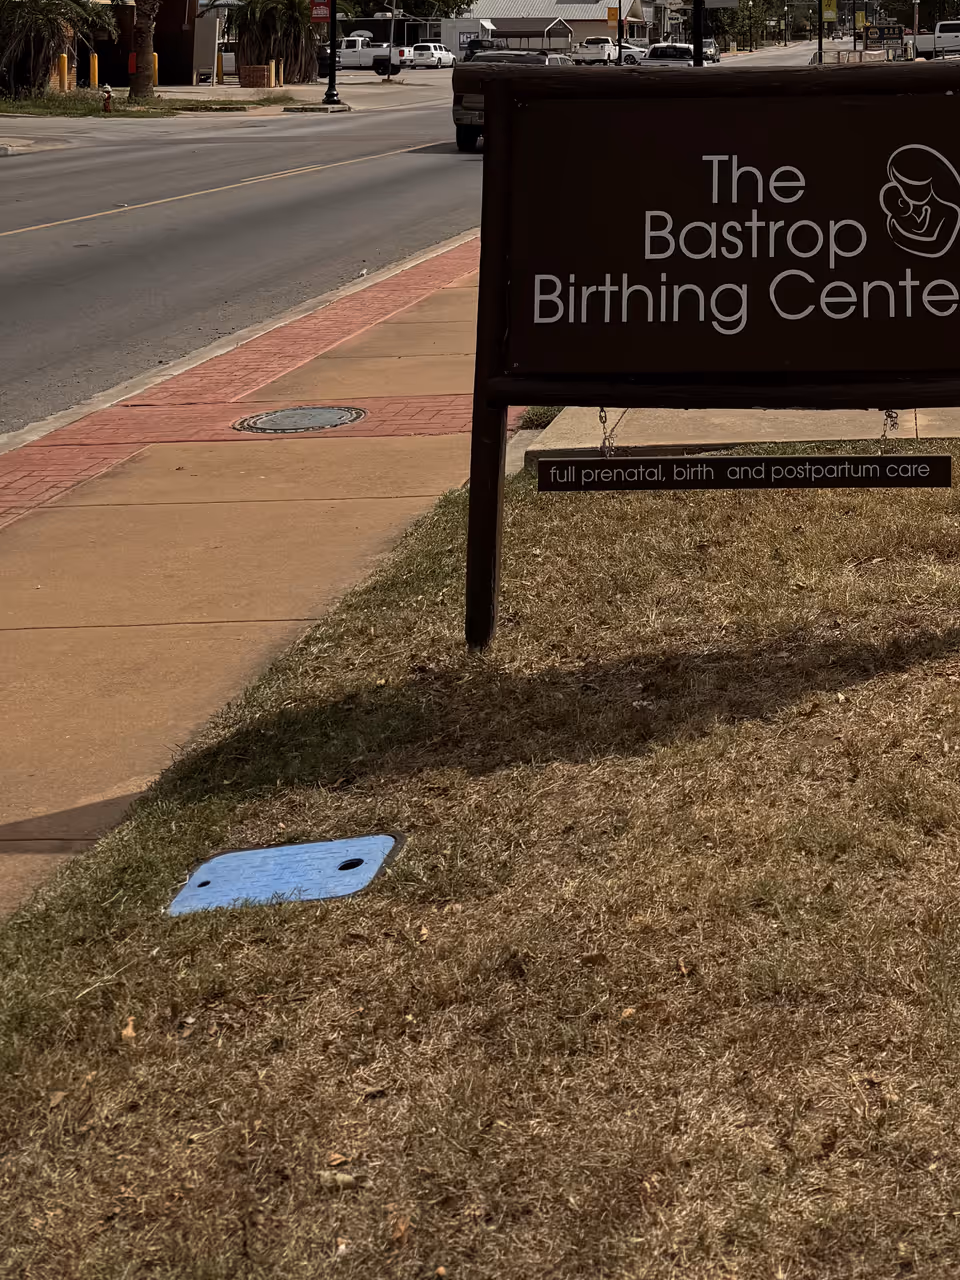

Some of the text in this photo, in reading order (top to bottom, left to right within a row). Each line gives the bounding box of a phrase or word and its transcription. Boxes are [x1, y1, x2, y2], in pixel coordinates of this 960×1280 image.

[703, 155, 806, 204] The
[644, 209, 868, 269] Bastrop
[533, 273, 748, 335] Birthing
[549, 461, 931, 487] full prenatal, birth and postpartum care
